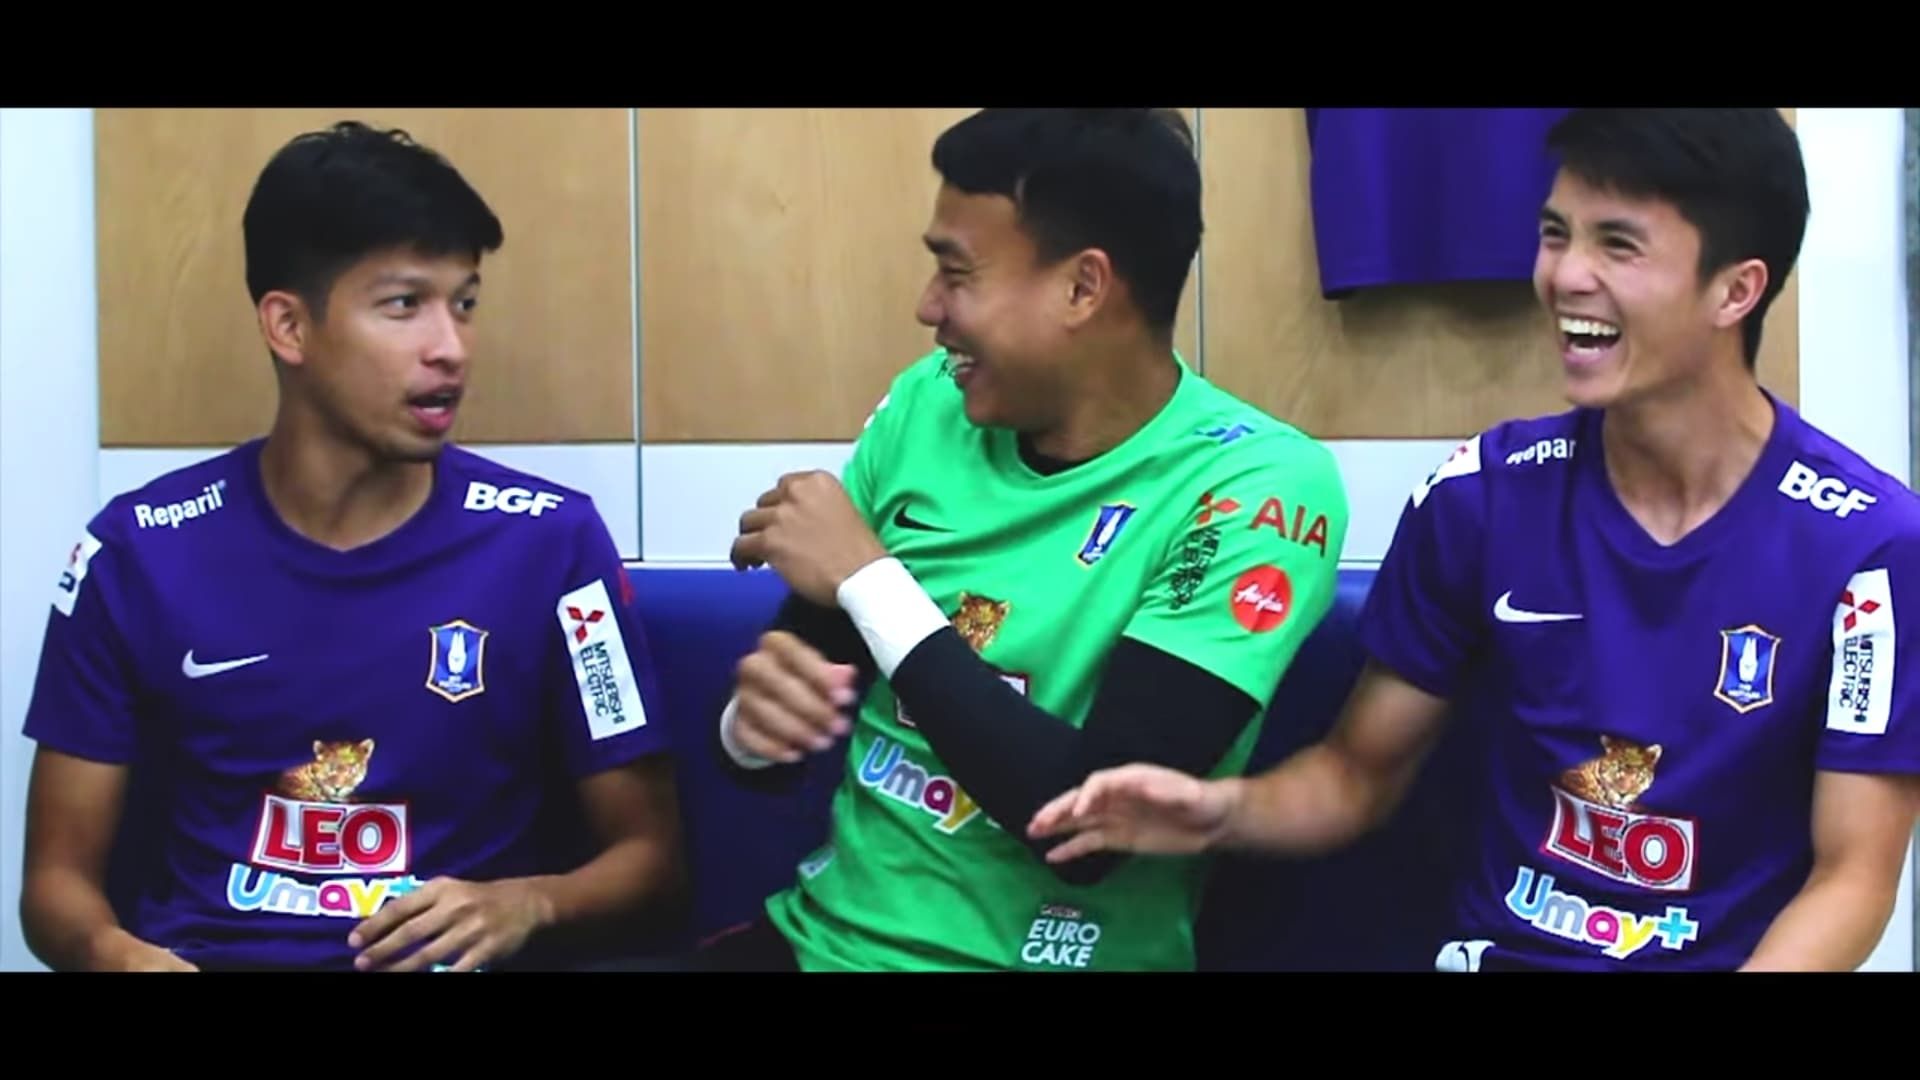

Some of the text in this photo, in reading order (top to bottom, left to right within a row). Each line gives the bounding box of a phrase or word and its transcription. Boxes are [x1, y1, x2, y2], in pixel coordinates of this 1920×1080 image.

[134, 483, 224, 529] Reparil
[464, 481, 564, 517] BGF
[1778, 460, 1877, 518] BGF
[1248, 496, 1328, 558] AIA
[579, 645, 609, 717] ELECTRIC
[1839, 636, 1858, 708] ELECTRIC
[858, 736, 1000, 834] Umay
[258, 800, 402, 871] LEO
[1551, 794, 1691, 886] LEO
[1028, 919, 1101, 945] EURO
[1505, 866, 1699, 960] Umay+
[1021, 941, 1094, 968] CAKE
